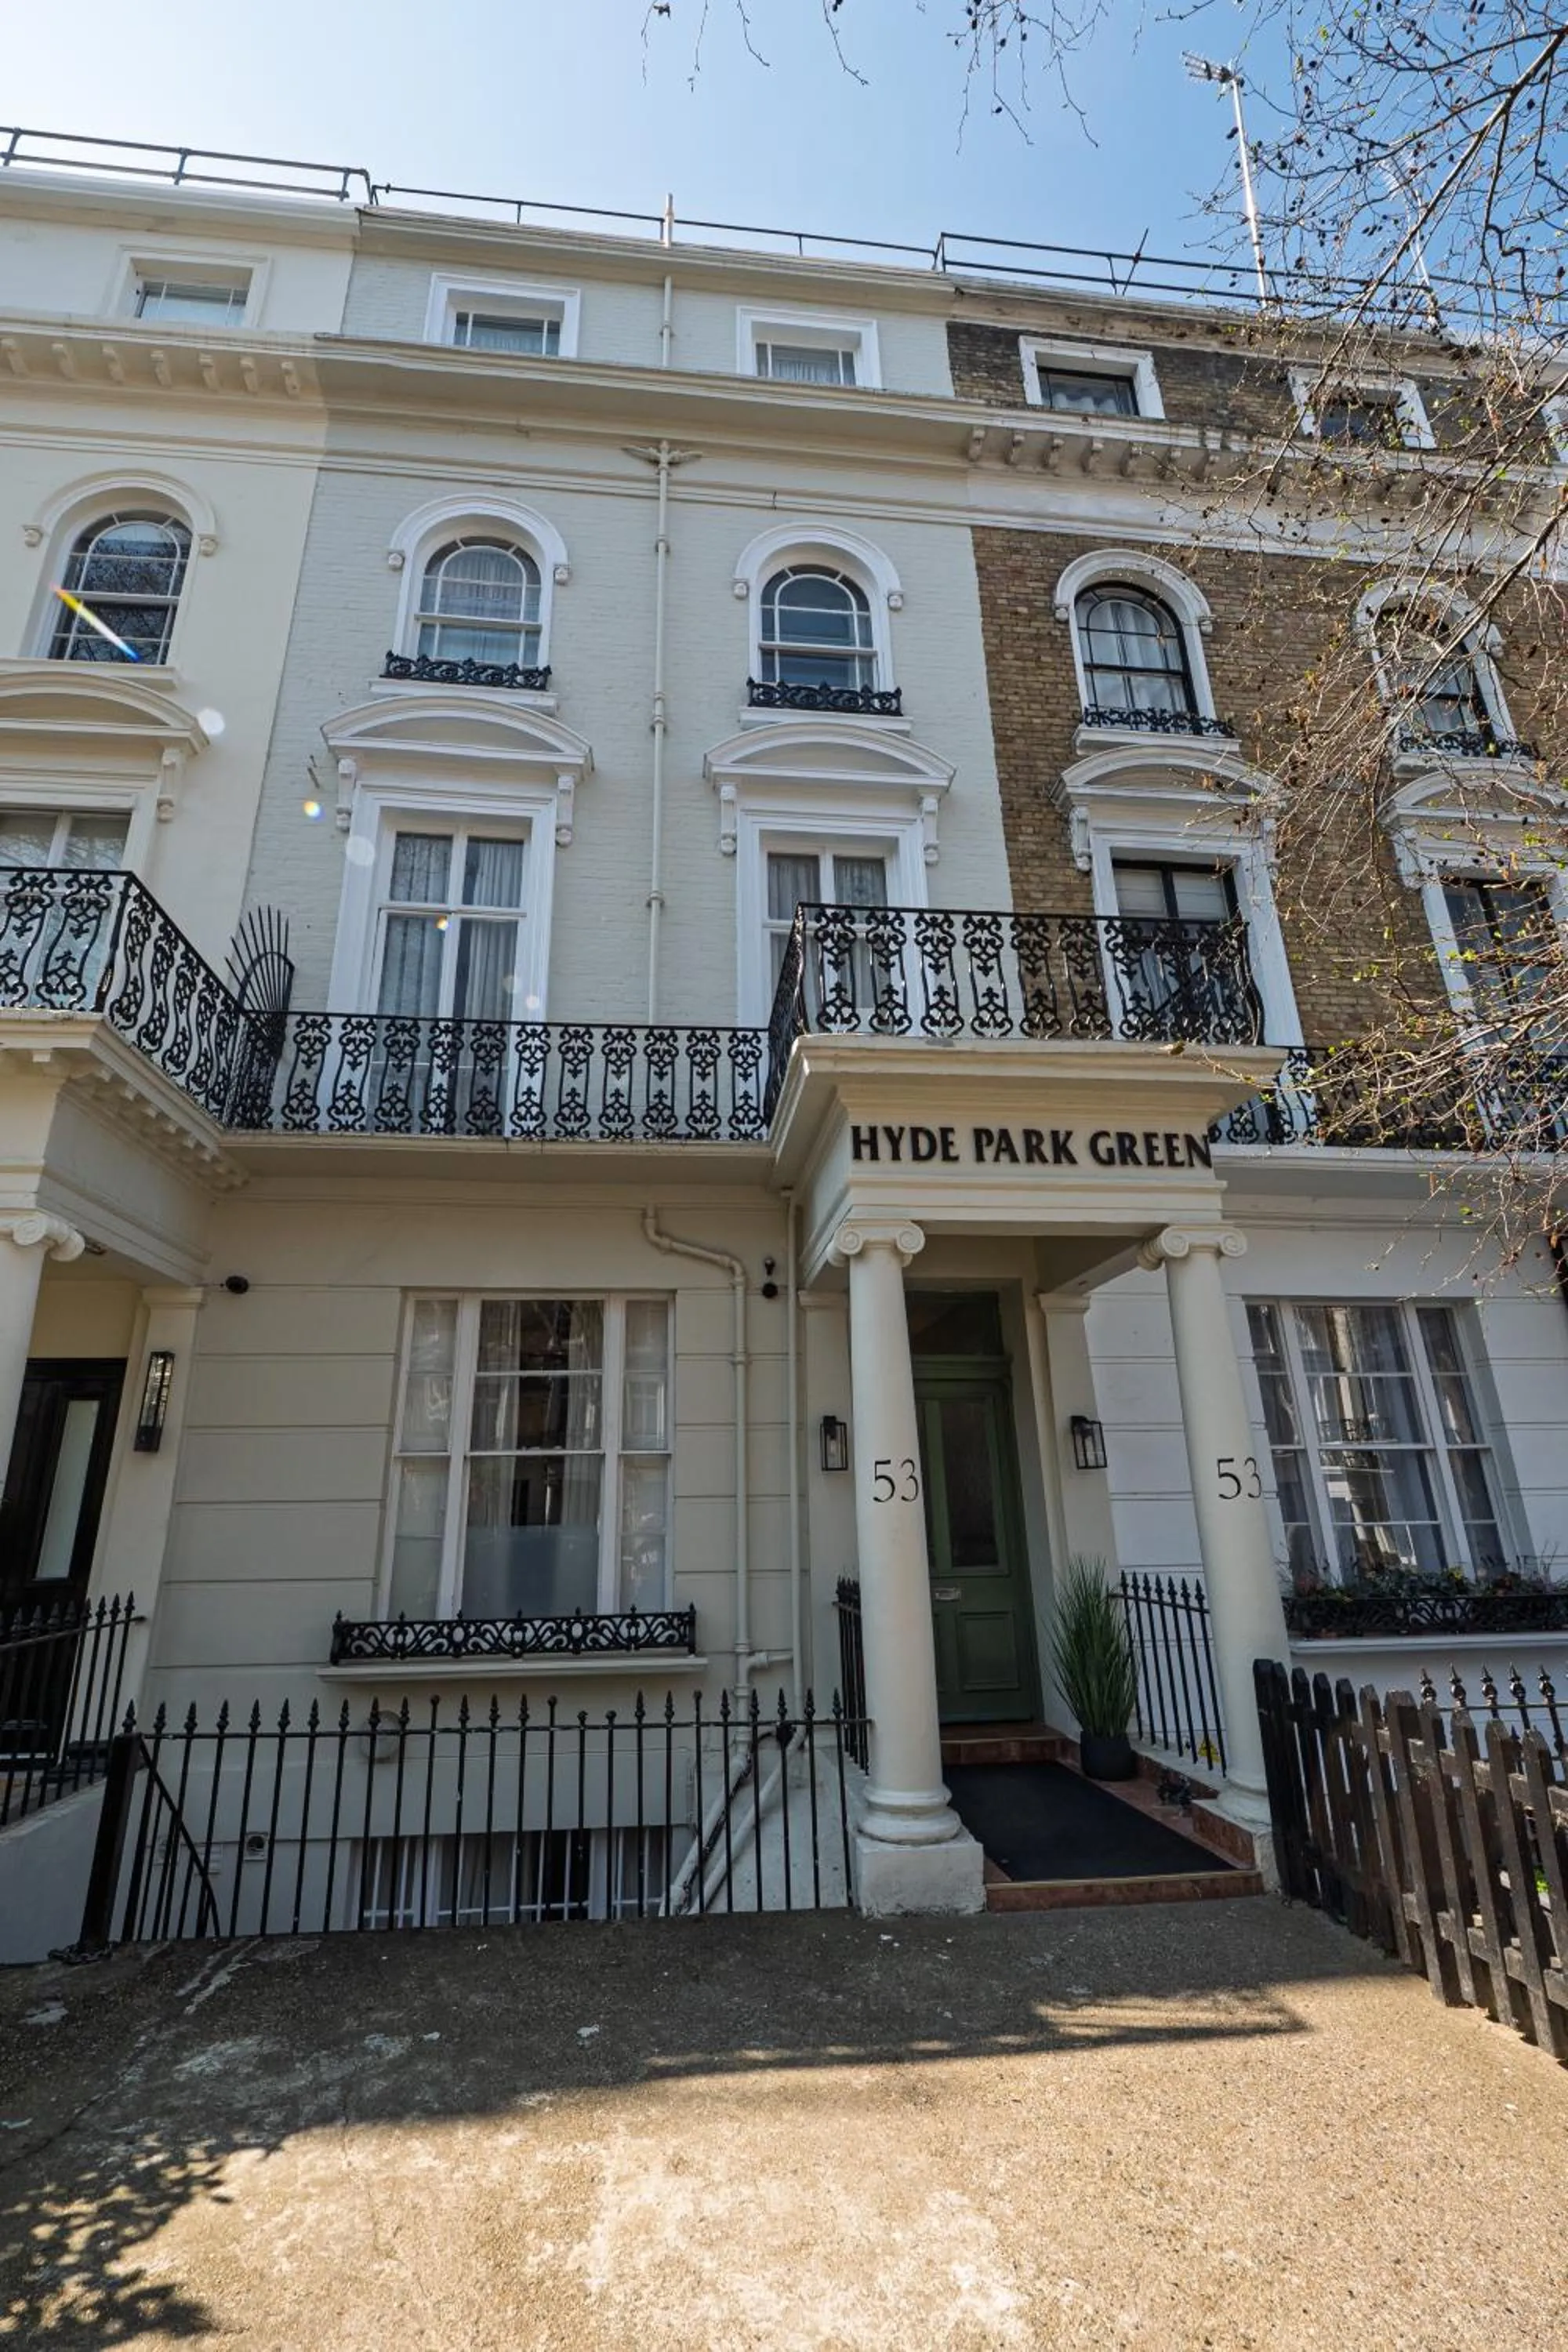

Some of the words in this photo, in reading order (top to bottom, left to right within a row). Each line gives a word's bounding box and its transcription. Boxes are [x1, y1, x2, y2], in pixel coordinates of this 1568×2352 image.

[851, 1125, 960, 1162] HYDE
[973, 1128, 1078, 1164] PARK
[1089, 1131, 1212, 1168] GREEN
[873, 1459, 918, 1502] 53
[1218, 1457, 1261, 1500] 53
